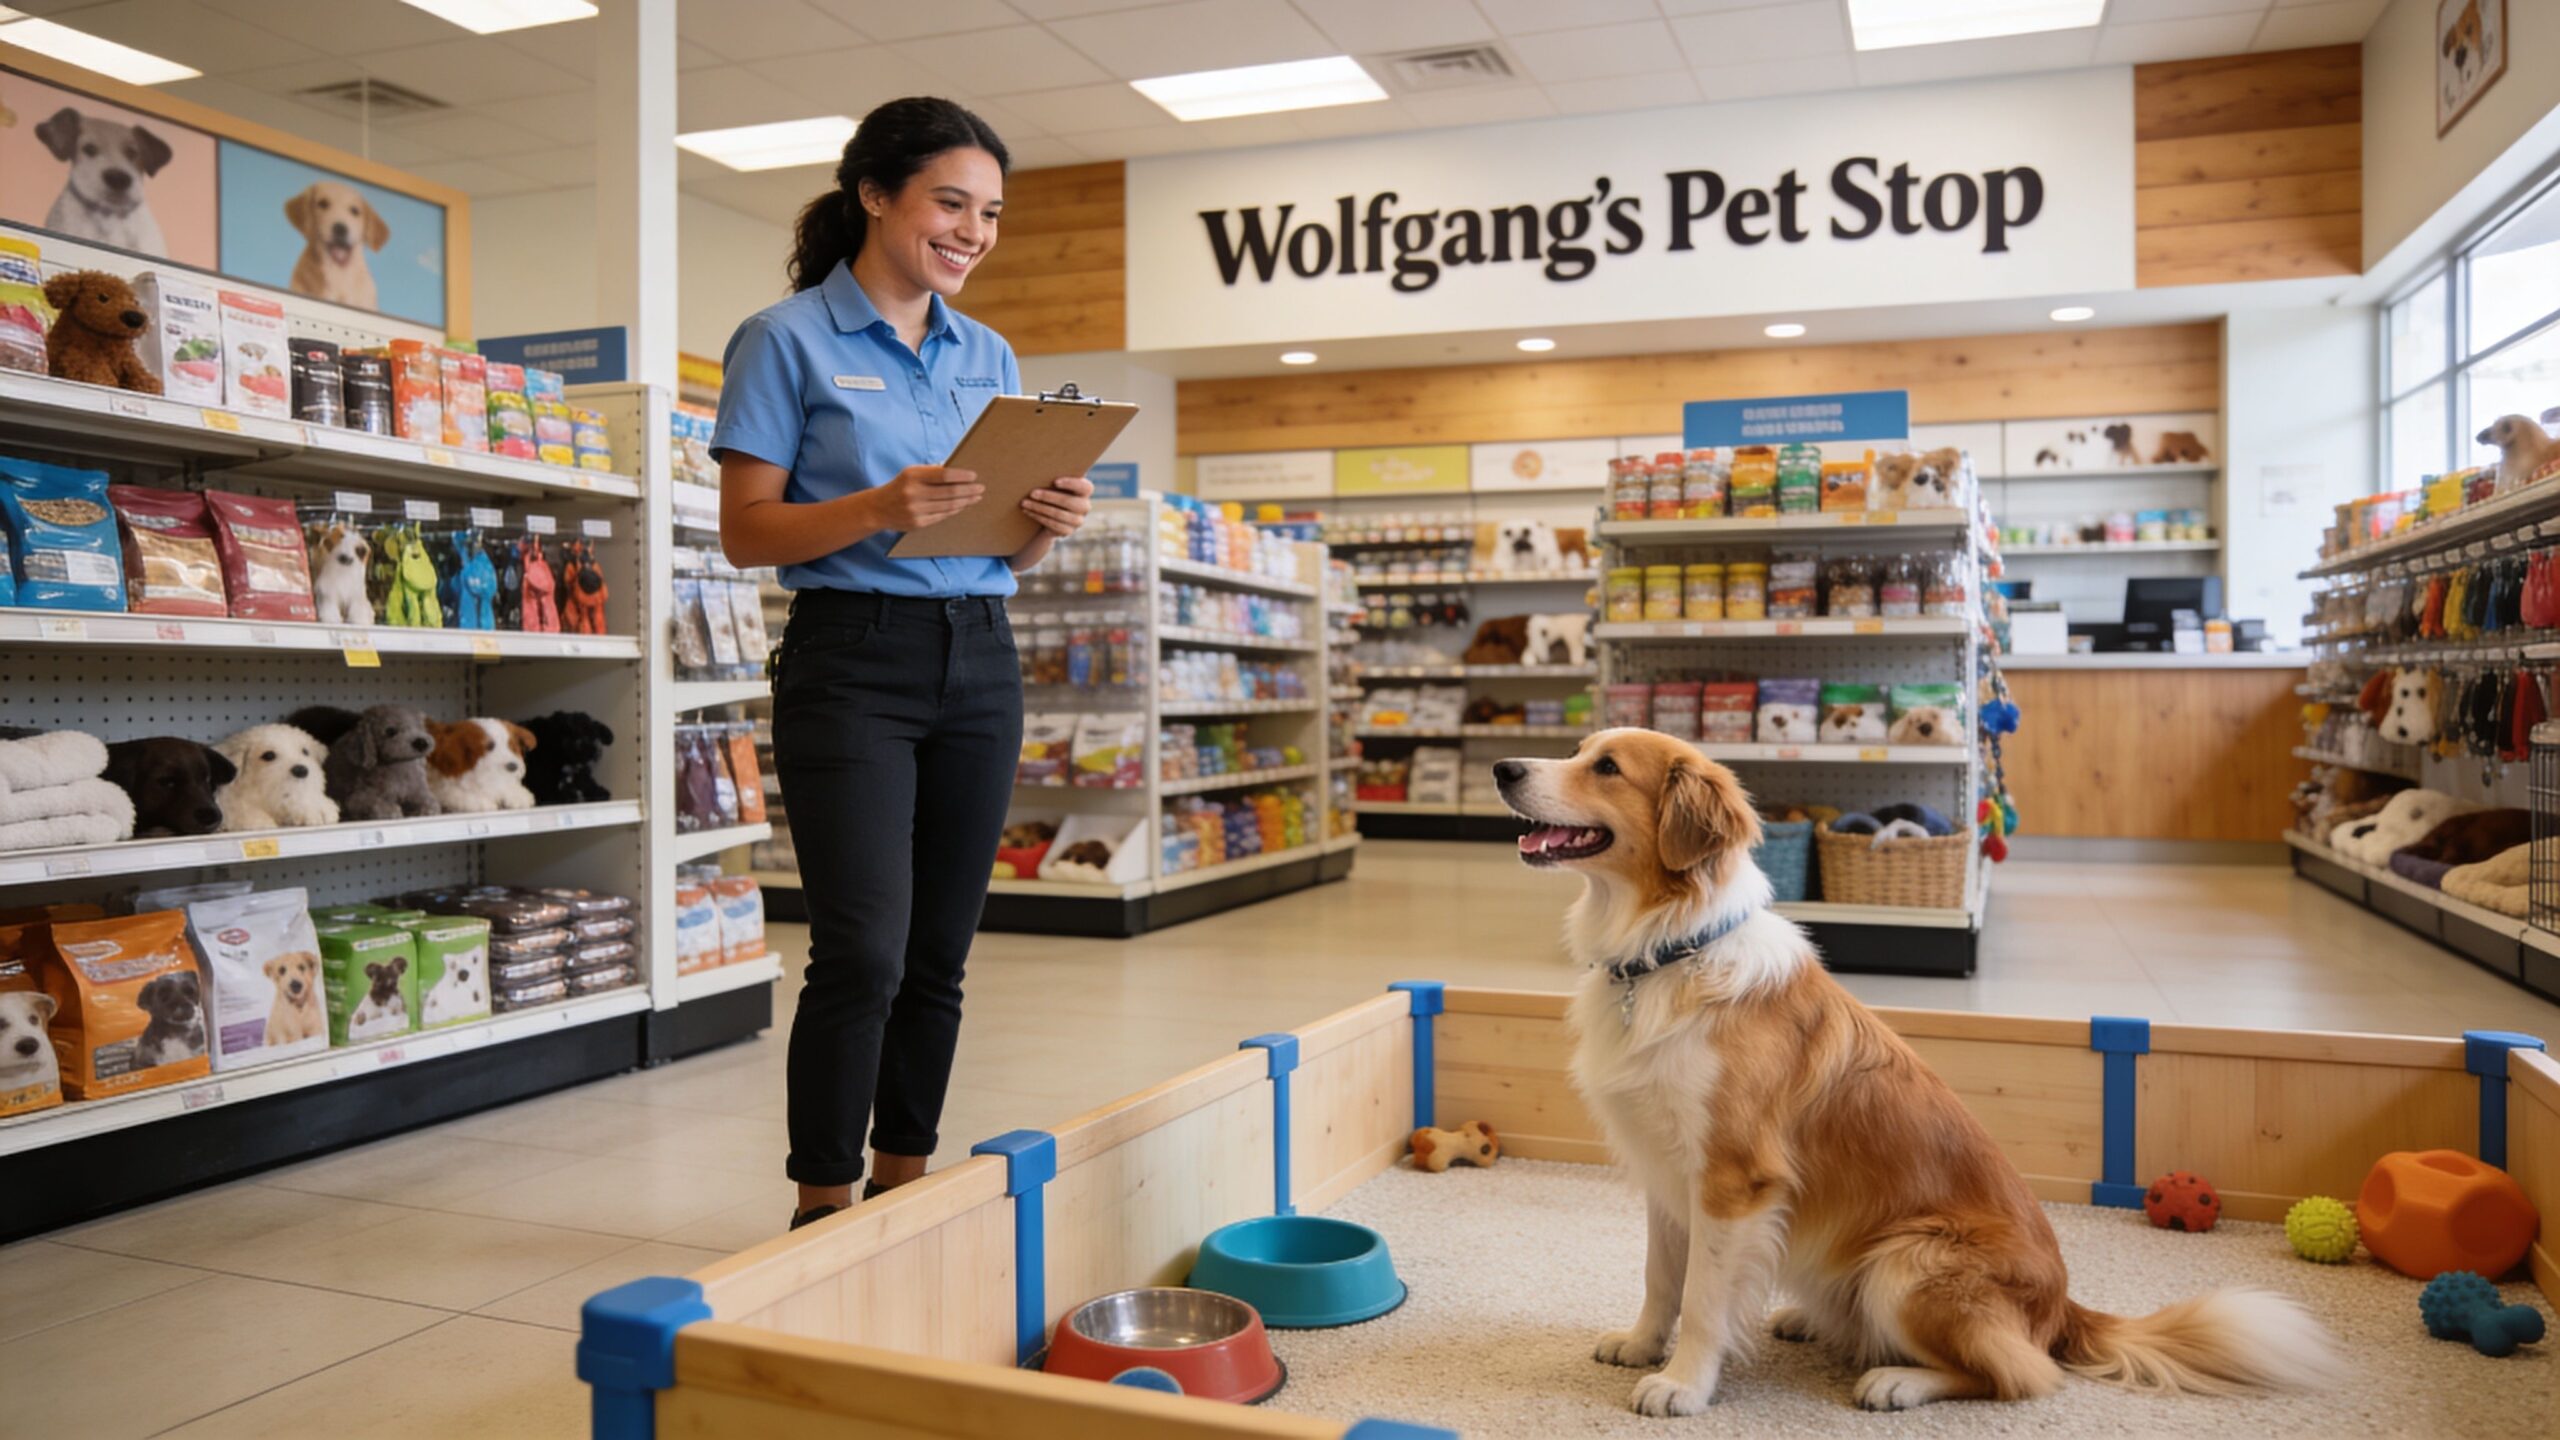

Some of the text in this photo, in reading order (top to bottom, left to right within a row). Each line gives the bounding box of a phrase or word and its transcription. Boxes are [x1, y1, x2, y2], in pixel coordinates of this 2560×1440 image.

[1198, 157, 2044, 293] Wolfgang's Pet Stop
